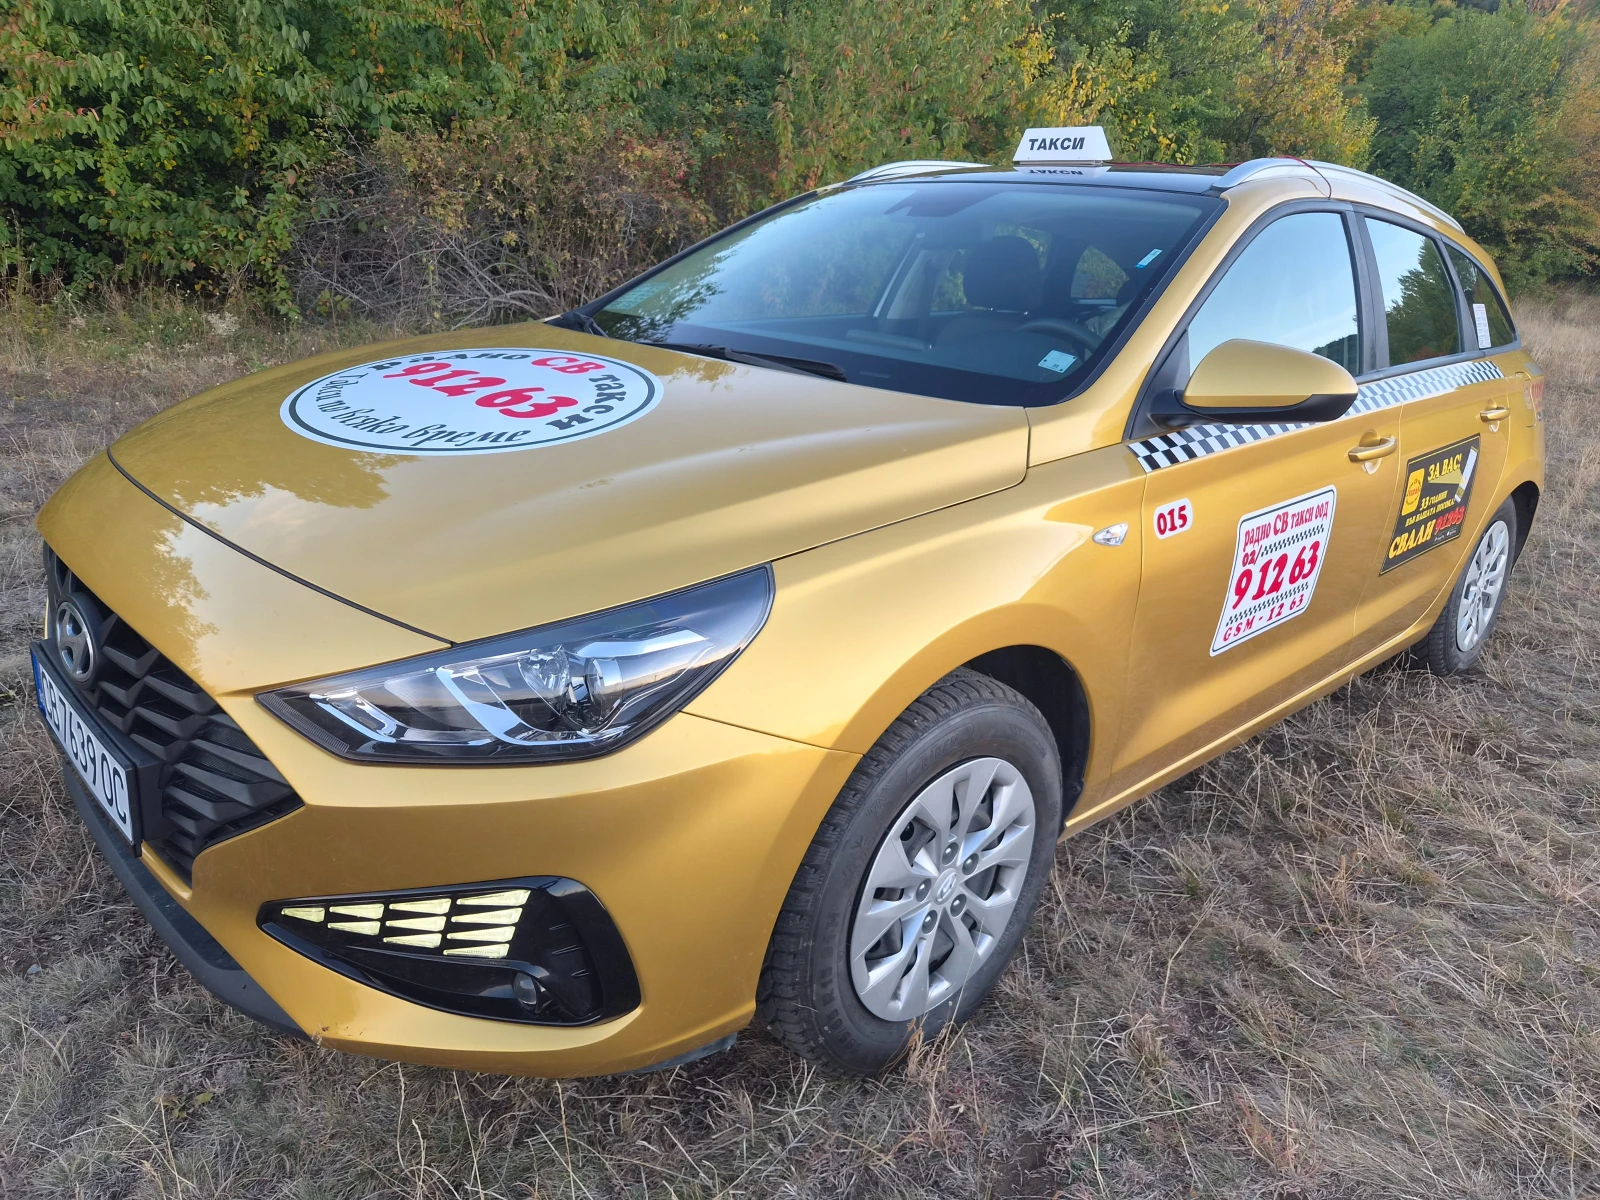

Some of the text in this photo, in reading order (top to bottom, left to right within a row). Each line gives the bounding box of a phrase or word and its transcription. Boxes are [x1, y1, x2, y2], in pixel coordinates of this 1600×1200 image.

[1028, 137, 1086, 151] ТАКСИ
[531, 356, 607, 375] СВ
[544, 373, 626, 431] такси
[330, 407, 411, 435] всяко
[401, 423, 532, 447] време
[1427, 461, 1442, 481] ЗА
[1156, 504, 1188, 536] 015
[1243, 521, 1271, 552] радио
[1273, 511, 1289, 536] СВ
[1291, 506, 1314, 529] такси
[1388, 518, 1437, 559] СВАЛИ
[1222, 615, 1256, 642] GSM
